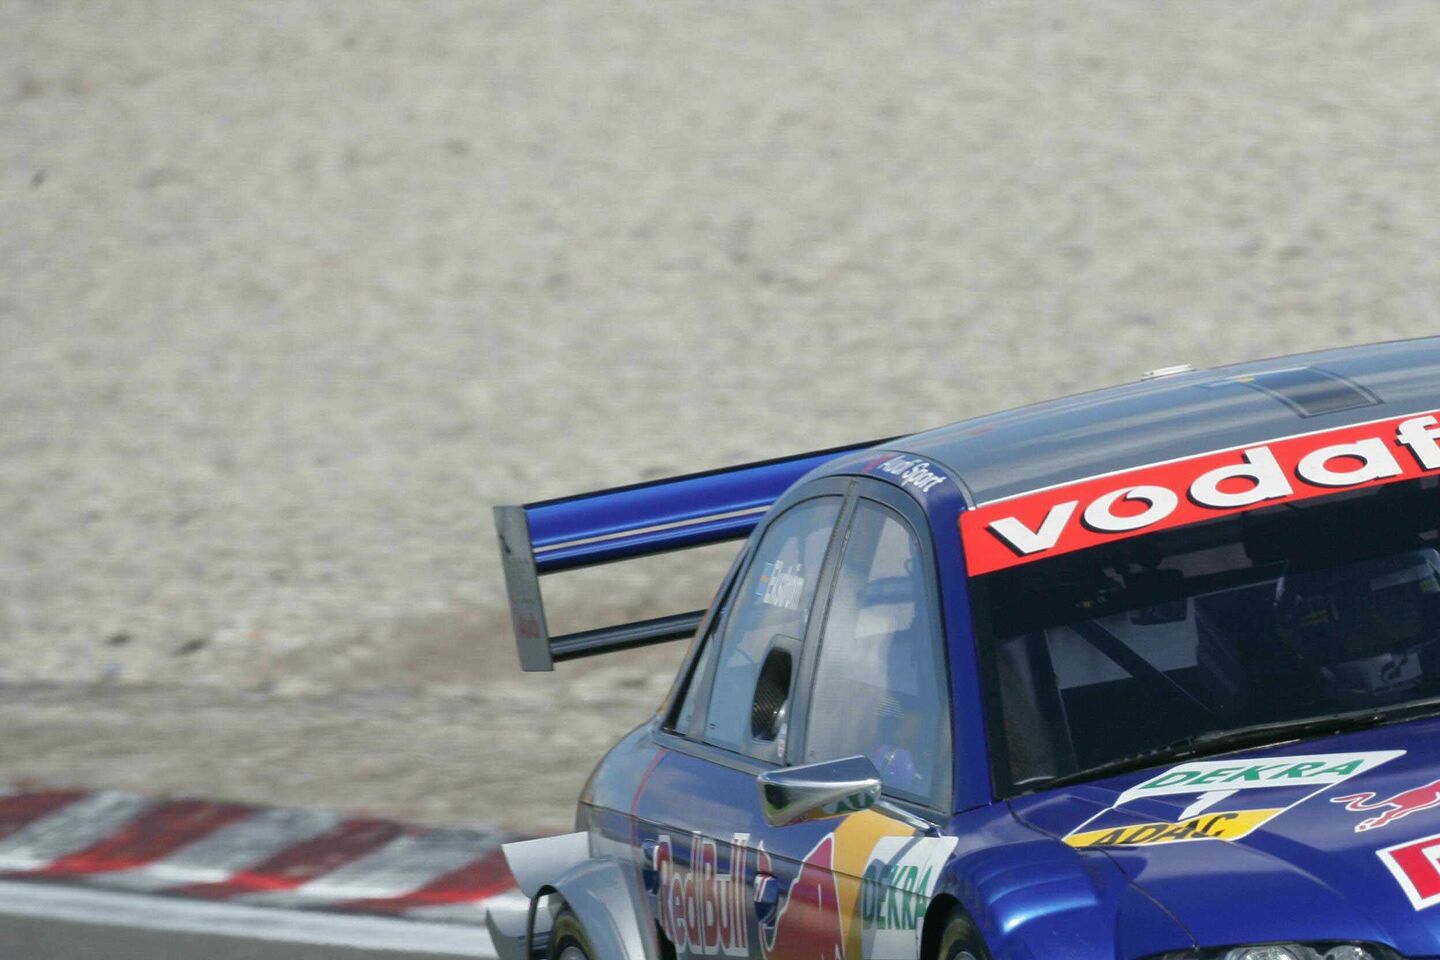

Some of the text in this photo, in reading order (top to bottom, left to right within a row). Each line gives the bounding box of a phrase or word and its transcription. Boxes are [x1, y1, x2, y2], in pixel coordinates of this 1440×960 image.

[901, 462, 947, 492] Sport
[1141, 759, 1365, 789] DEKRA
[1177, 789, 1241, 821] 1
[1089, 813, 1239, 846] ADAC
[700, 832, 749, 956] Bull
